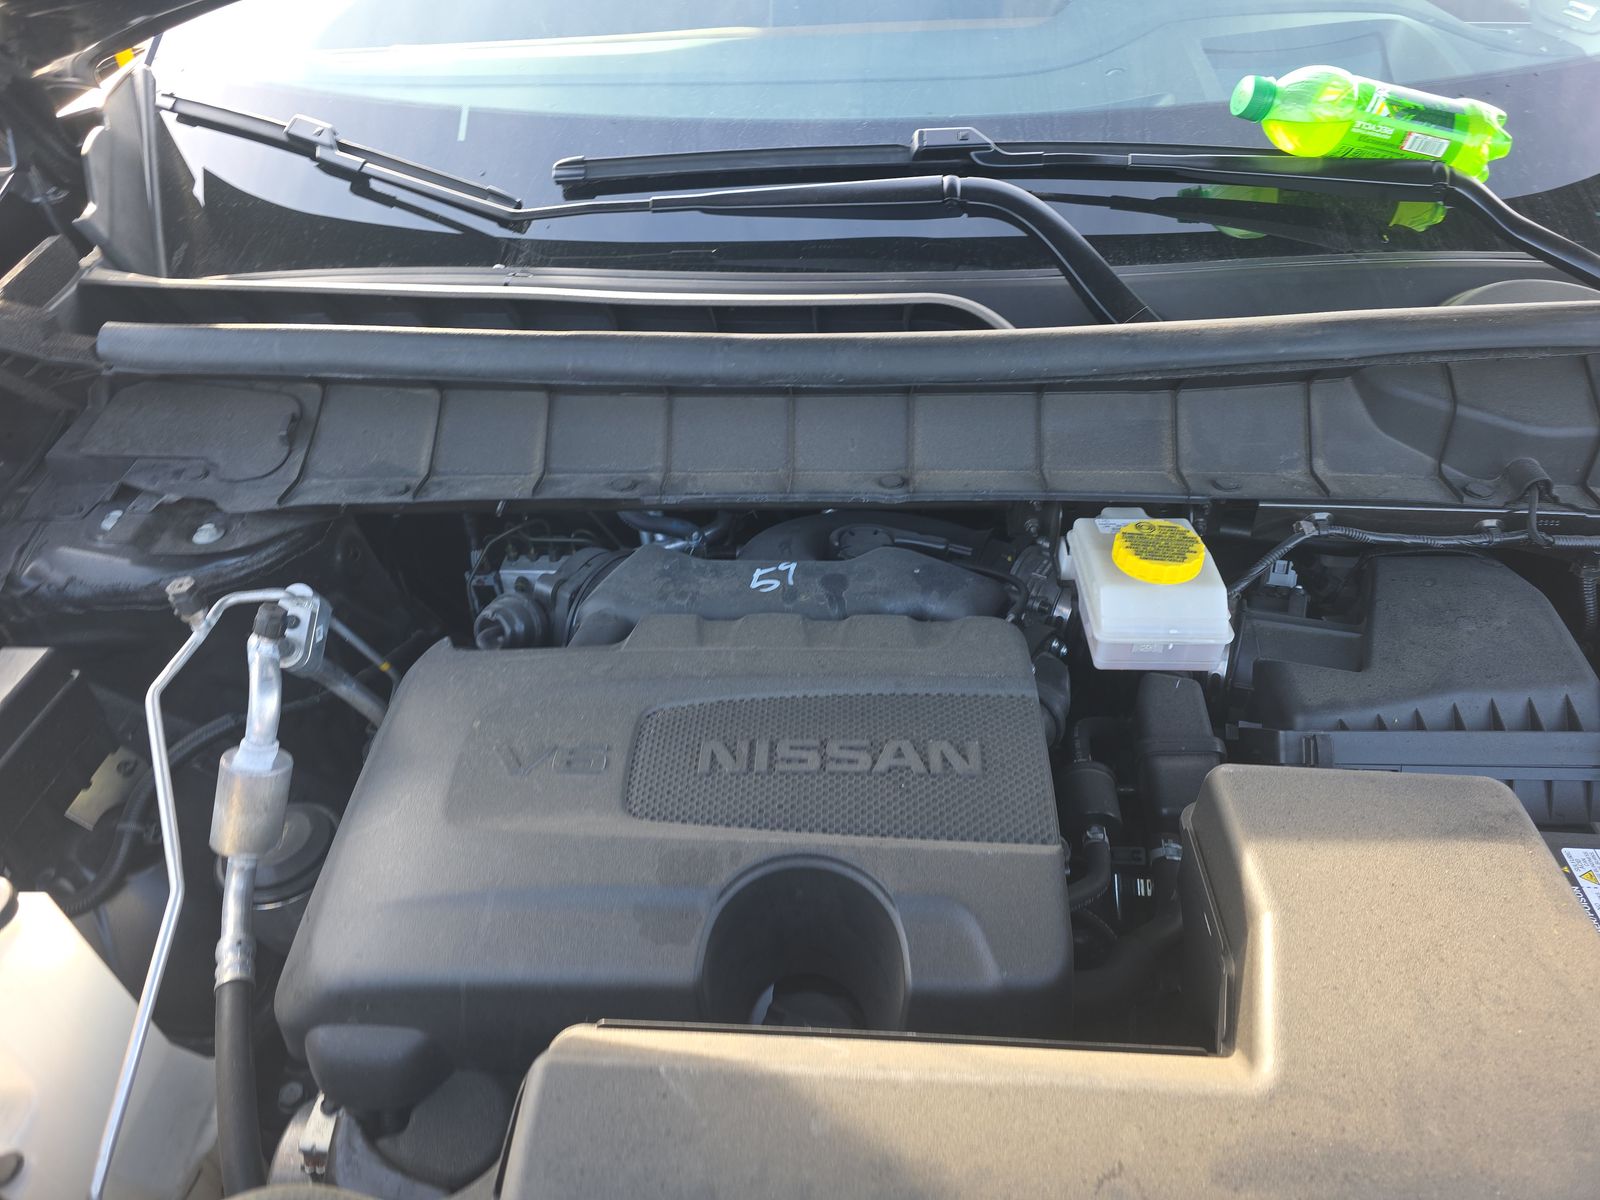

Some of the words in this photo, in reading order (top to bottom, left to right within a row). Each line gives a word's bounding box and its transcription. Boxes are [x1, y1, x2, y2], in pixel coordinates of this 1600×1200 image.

[1352, 119, 1395, 136] RECYCLE
[749, 561, 798, 593] 59
[698, 737, 983, 778] NISSAN
